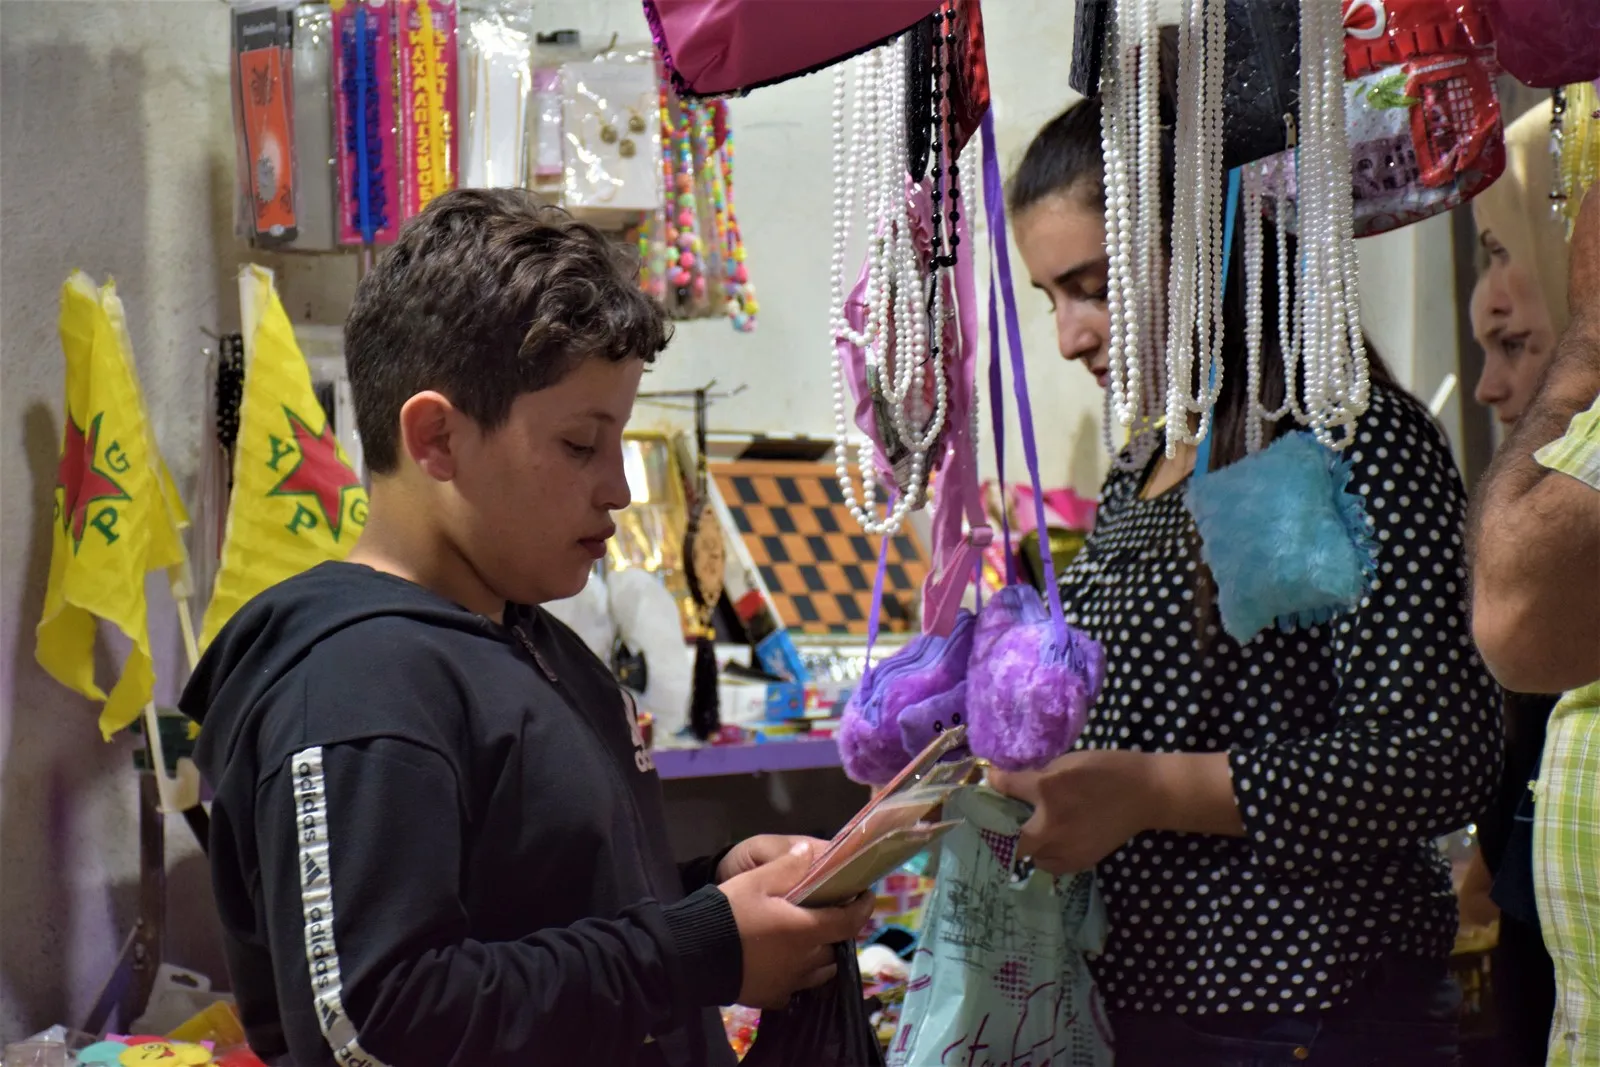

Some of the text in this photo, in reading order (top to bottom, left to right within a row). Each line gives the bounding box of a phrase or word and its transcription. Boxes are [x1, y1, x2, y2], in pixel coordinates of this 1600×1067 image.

[91, 440, 130, 546] P G
[266, 434, 294, 471] Y
[285, 502, 317, 535] P
[299, 762, 319, 842] adidas
[309, 907, 331, 989] adidas
